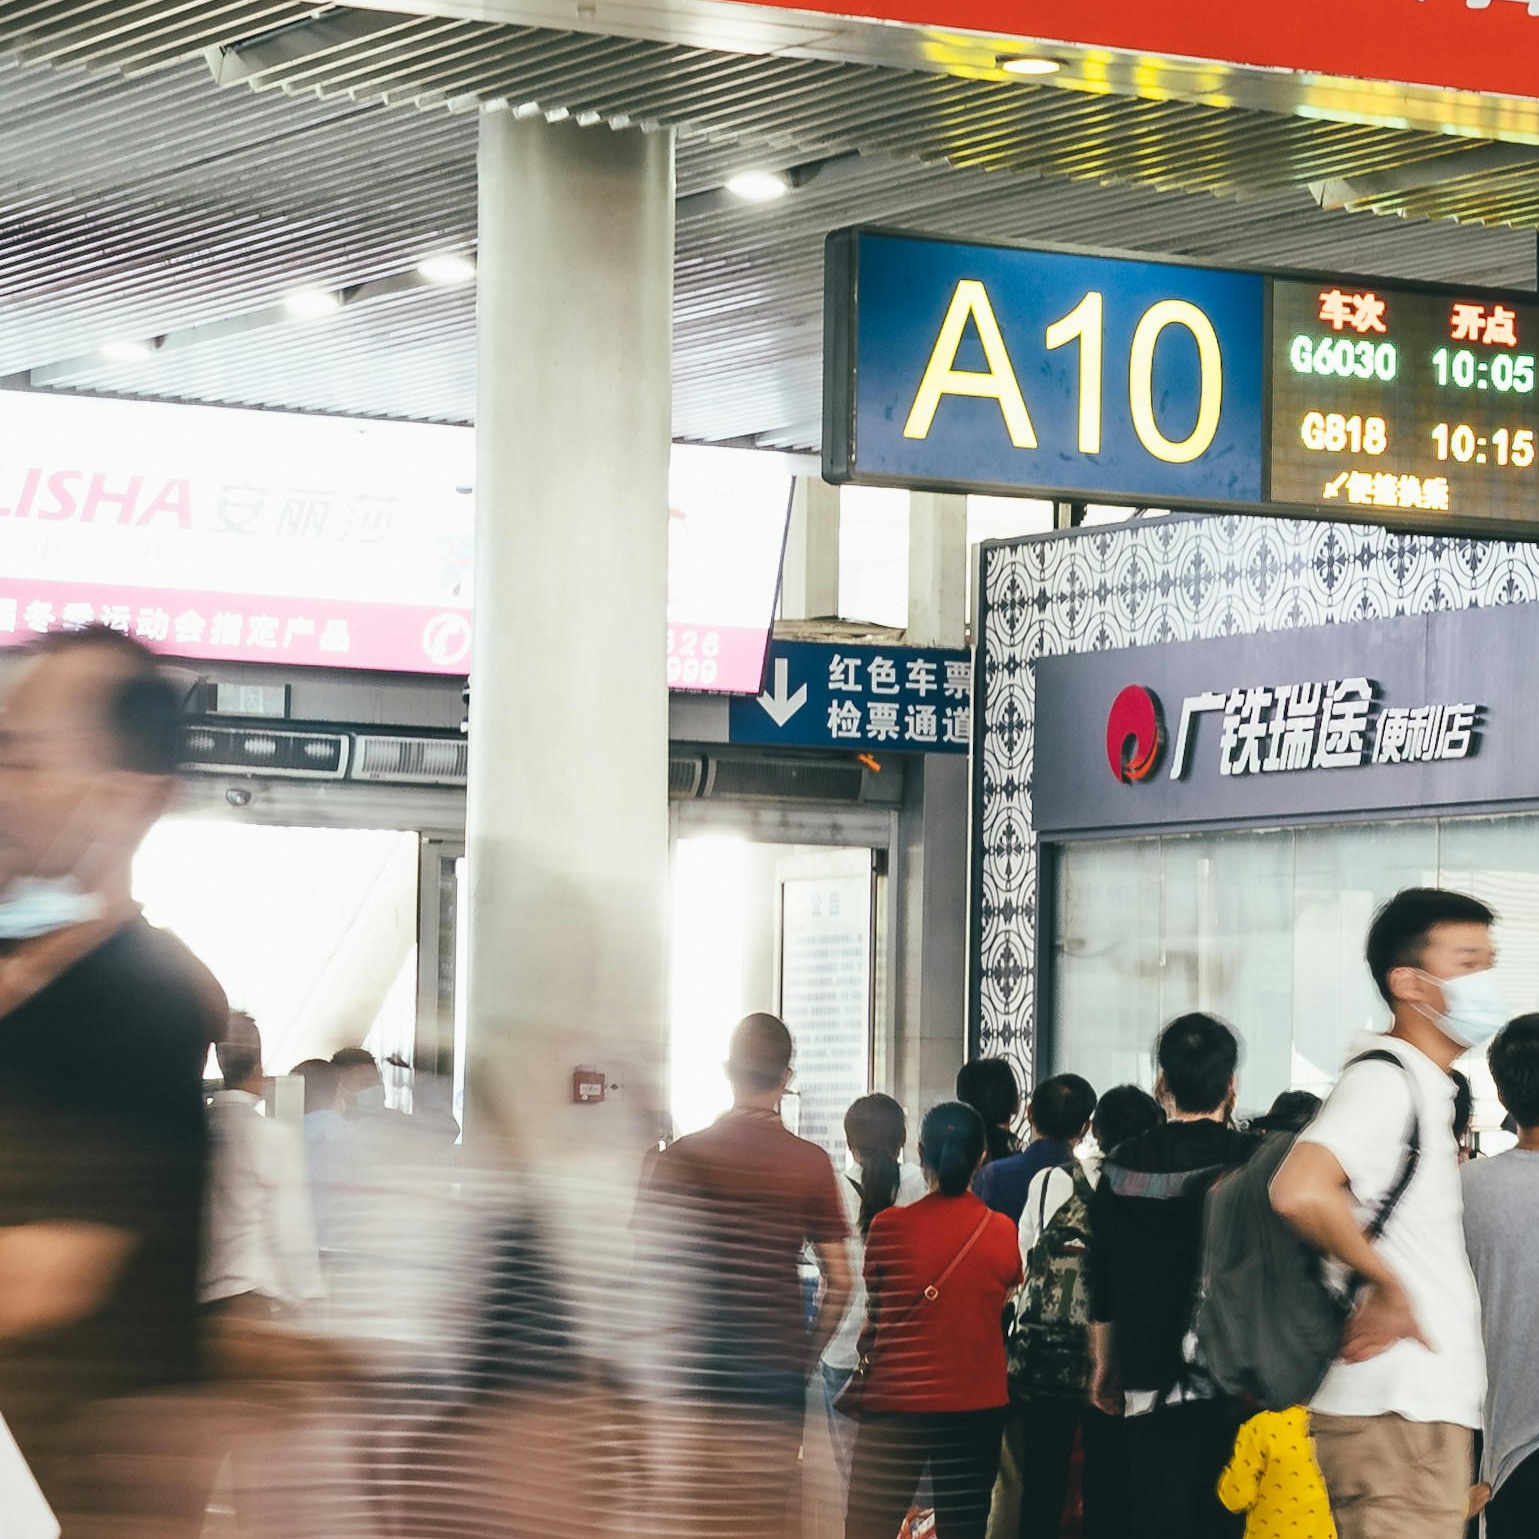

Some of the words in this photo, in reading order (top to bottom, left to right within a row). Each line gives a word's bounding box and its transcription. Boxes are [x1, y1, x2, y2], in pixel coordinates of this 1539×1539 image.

[1318, 288, 1388, 334] 车次
[1450, 302, 1518, 348] 开点
[902, 278, 1224, 464] A10
[1290, 334, 1398, 383] G6030
[1432, 346, 1537, 395] 10:05
[1300, 411, 1388, 456] G818
[1431, 422, 1536, 468] 10:15
[0, 467, 193, 530] ISHA
[208, 482, 401, 544] 安丽莎
[828, 653, 971, 699] 红色车票
[827, 699, 970, 744] 检票通道
